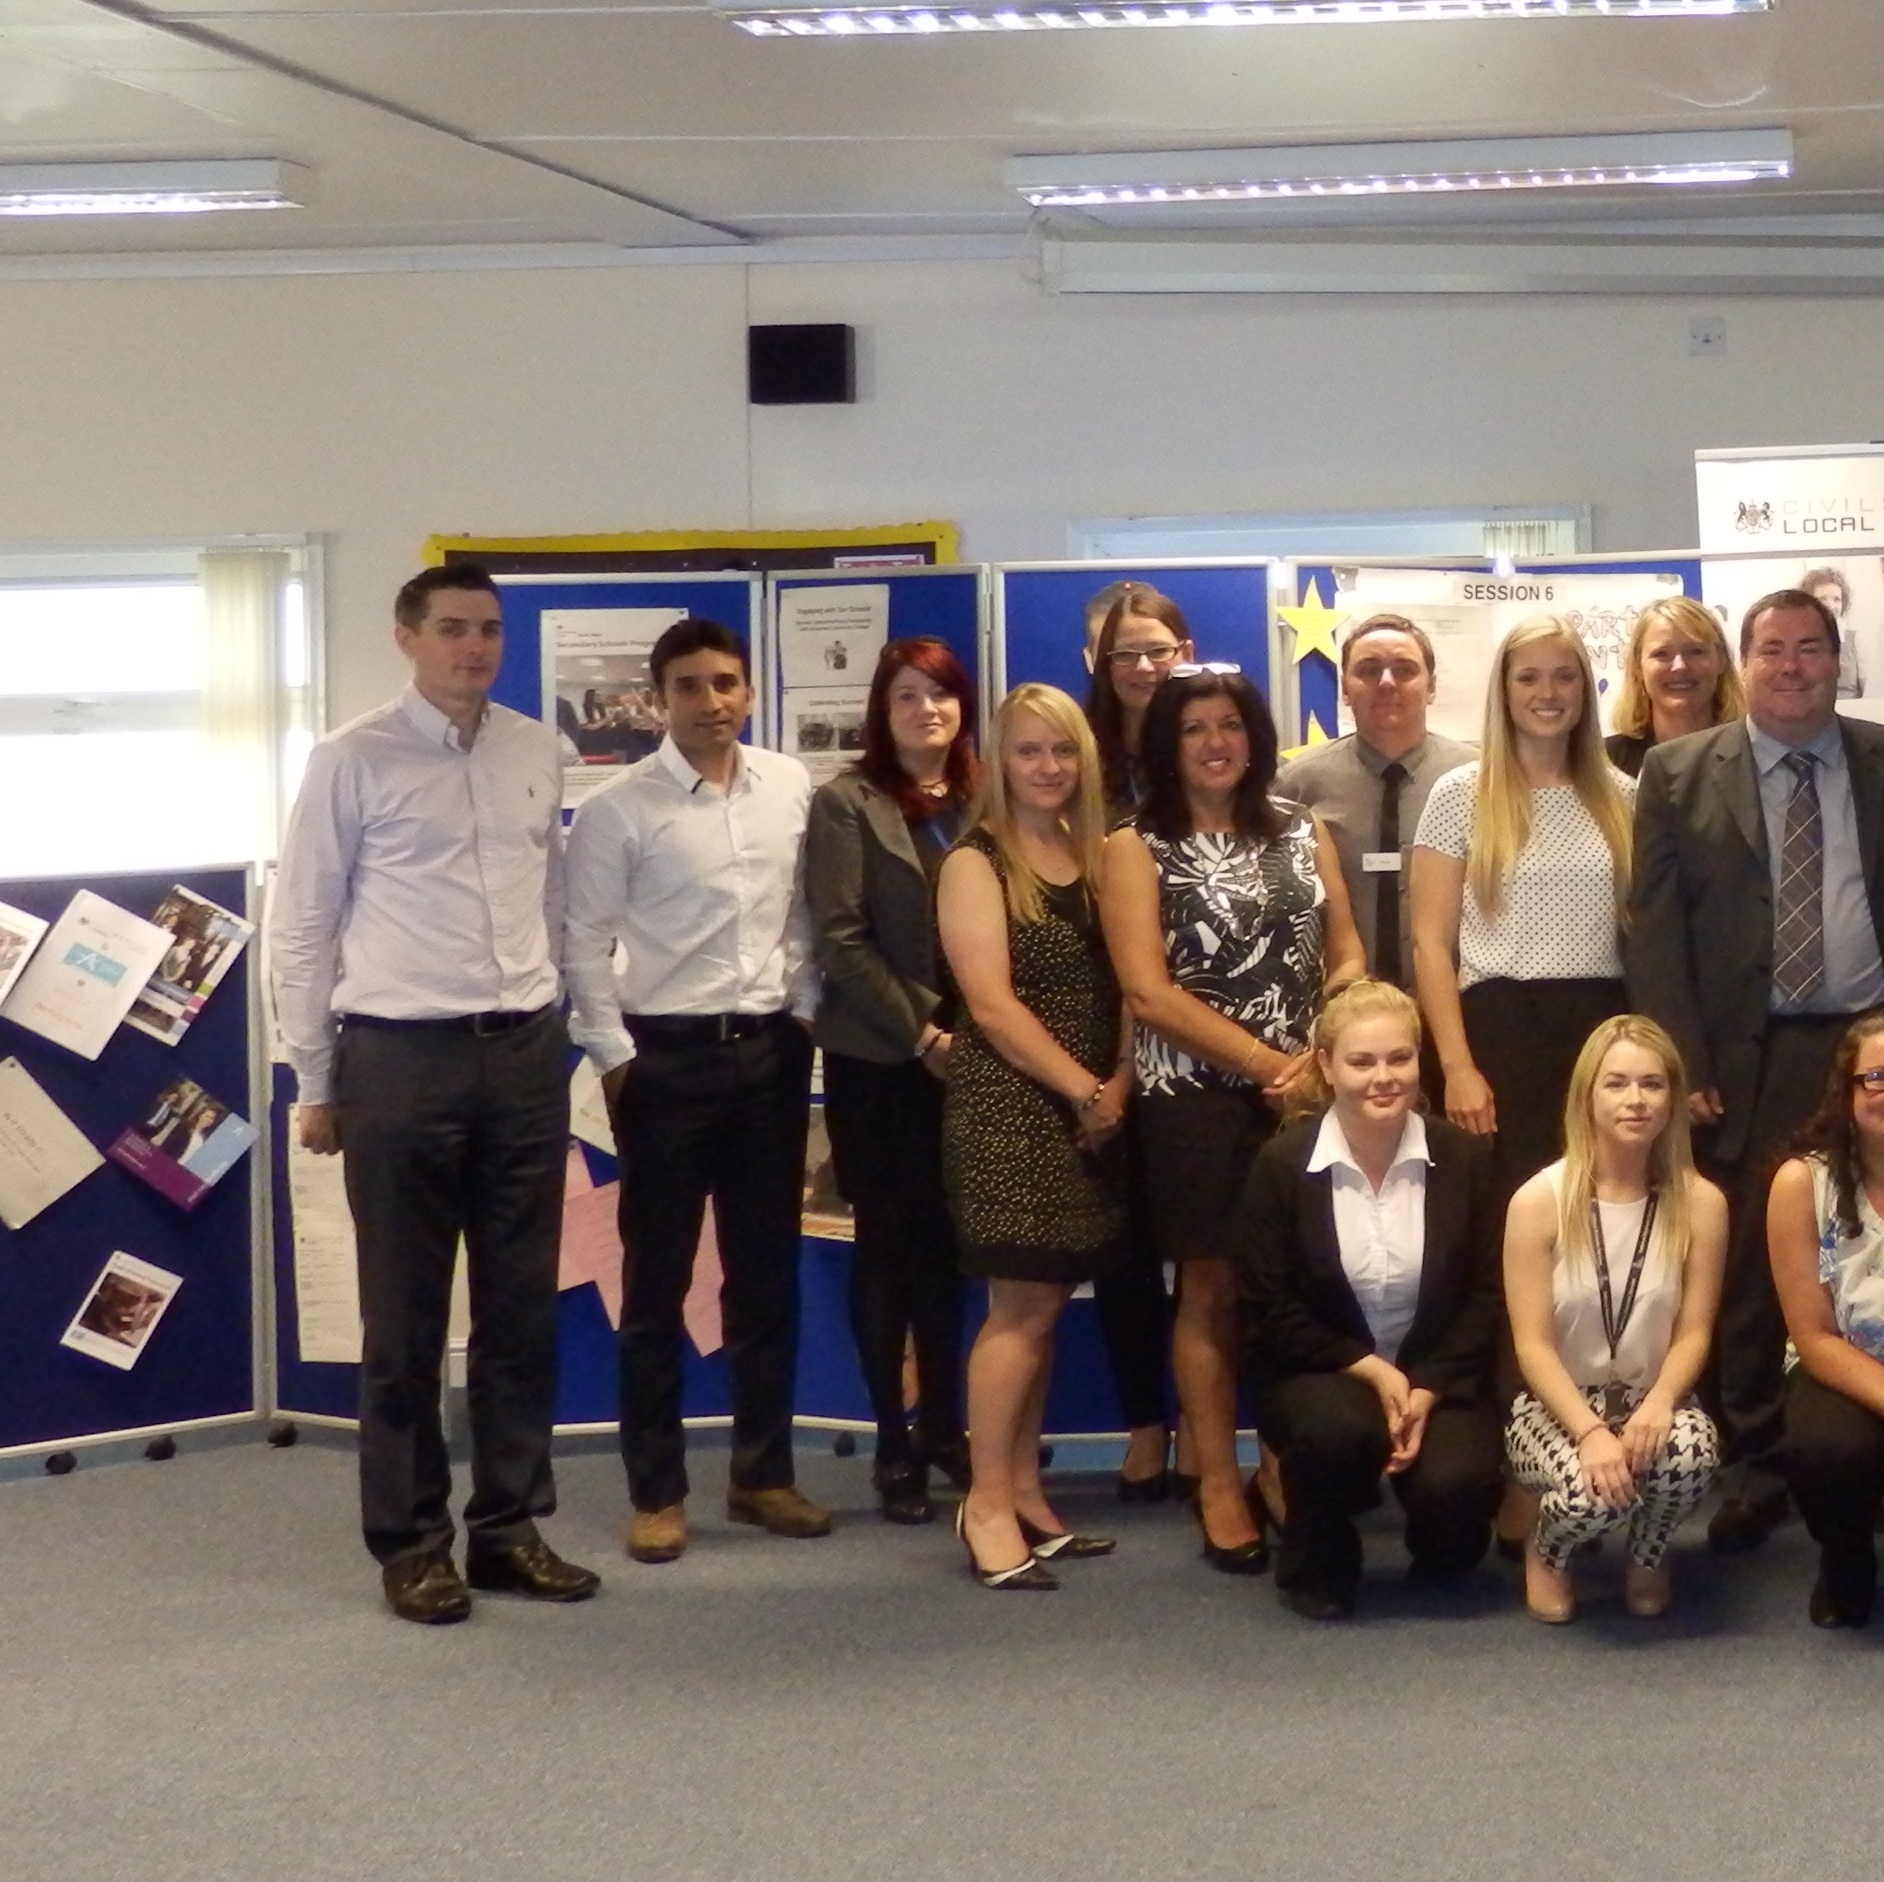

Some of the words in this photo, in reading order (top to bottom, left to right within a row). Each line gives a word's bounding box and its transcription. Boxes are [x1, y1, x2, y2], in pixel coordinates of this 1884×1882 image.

[1783, 516, 1875, 535] LOCAL
[1463, 584, 1541, 601] SESSION
[1545, 586, 1554, 601] 6
